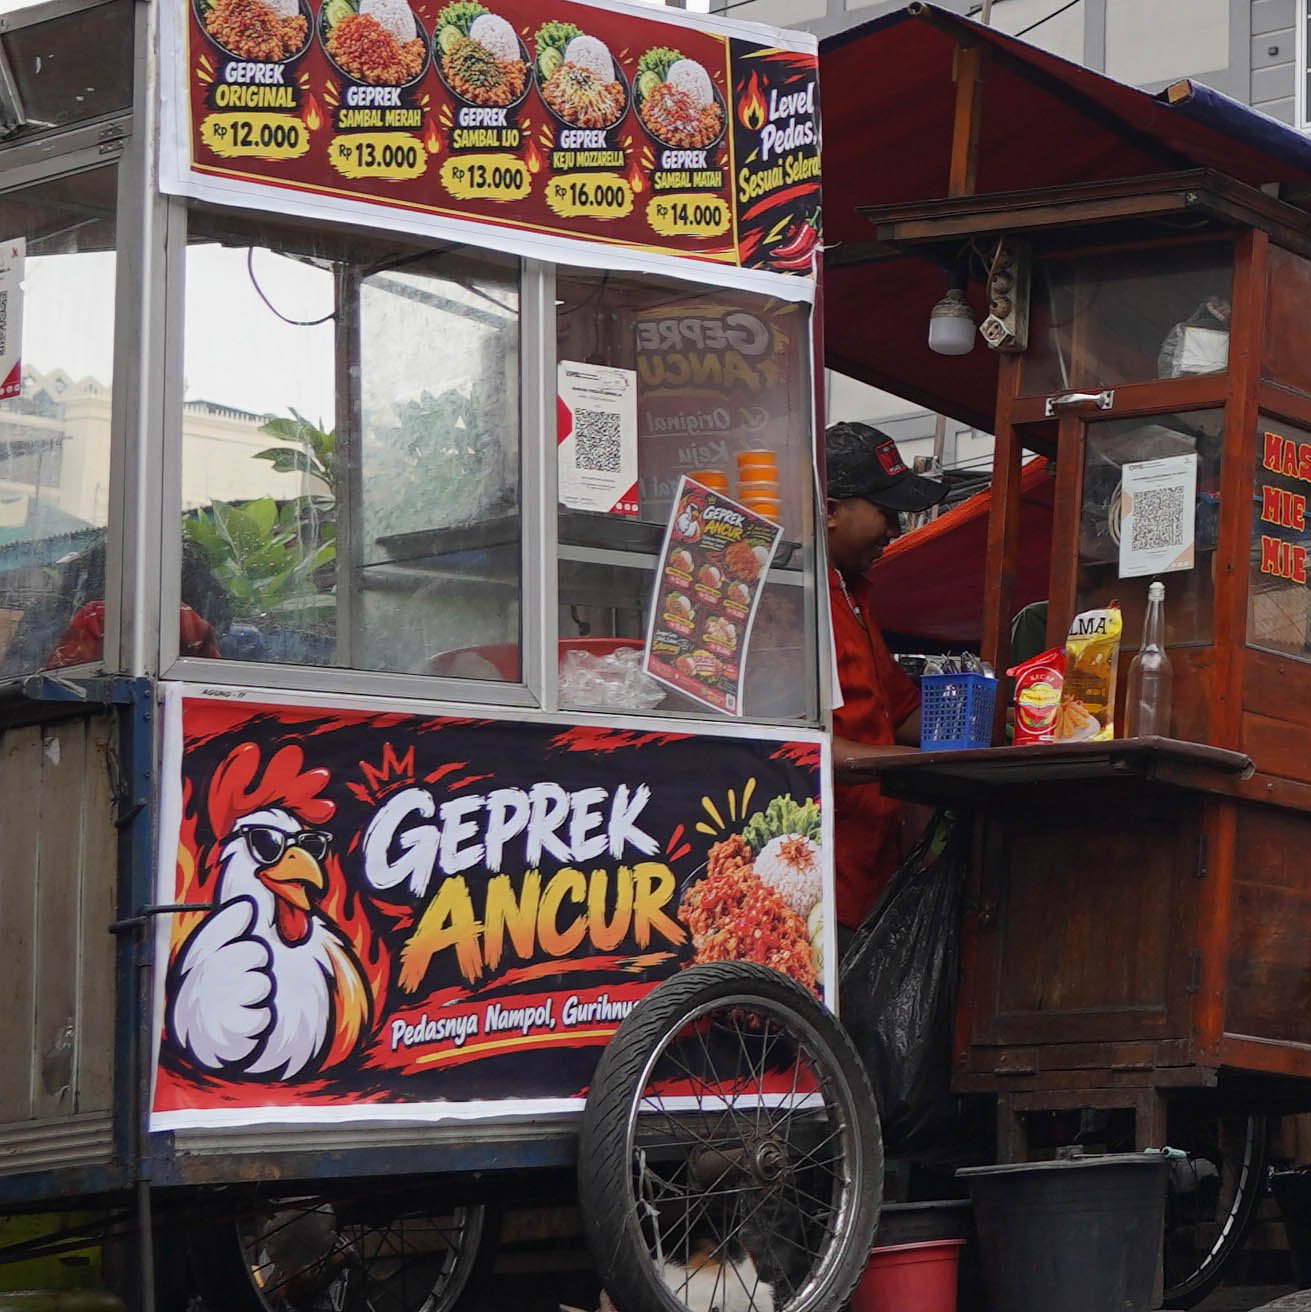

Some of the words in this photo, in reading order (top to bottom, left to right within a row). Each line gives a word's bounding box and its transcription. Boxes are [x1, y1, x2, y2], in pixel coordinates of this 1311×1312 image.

[225, 61, 284, 84] GEPREK
[215, 85, 297, 108] ORIGINAL
[346, 87, 402, 107] GEPREK
[768, 81, 816, 122] Level
[339, 110, 384, 128] SAMBAL
[385, 109, 422, 127] MERAH
[459, 108, 508, 127] GEPREK
[213, 123, 228, 140] Rp
[231, 121, 299, 148] 12.000
[453, 130, 499, 149] SAMBAL
[501, 129, 520, 147] IJO
[560, 130, 607, 149] GEPREK
[761, 116, 818, 161] Pedas,
[338, 143, 353, 160] Rp
[356, 143, 417, 169] 13.000
[553, 152, 575, 169] KEJU
[576, 151, 624, 168] MOZZARELLA
[662, 150, 708, 169] GEPREK
[452, 166, 466, 184] Rp
[467, 165, 524, 190] 13.000
[654, 173, 692, 189] SAMBAL
[693, 172, 722, 188] MATAH
[739, 159, 784, 203] Sesuai
[555, 187, 568, 204] Rp
[569, 183, 625, 207] 16.000
[656, 204, 668, 220] Rp
[671, 203, 722, 226] 14.000
[703, 506, 745, 527] GEPREK
[1261, 486, 1306, 532] MIE
[704, 520, 743, 541] ANCUR
[1260, 535, 1306, 583] MIE
[363, 783, 660, 898] GEPREK
[398, 862, 688, 994] ANCUR
[391, 1014, 478, 1049] Pedasnya
[485, 998, 555, 1035] Nampol,
[562, 994, 640, 1026] Gurihnu
